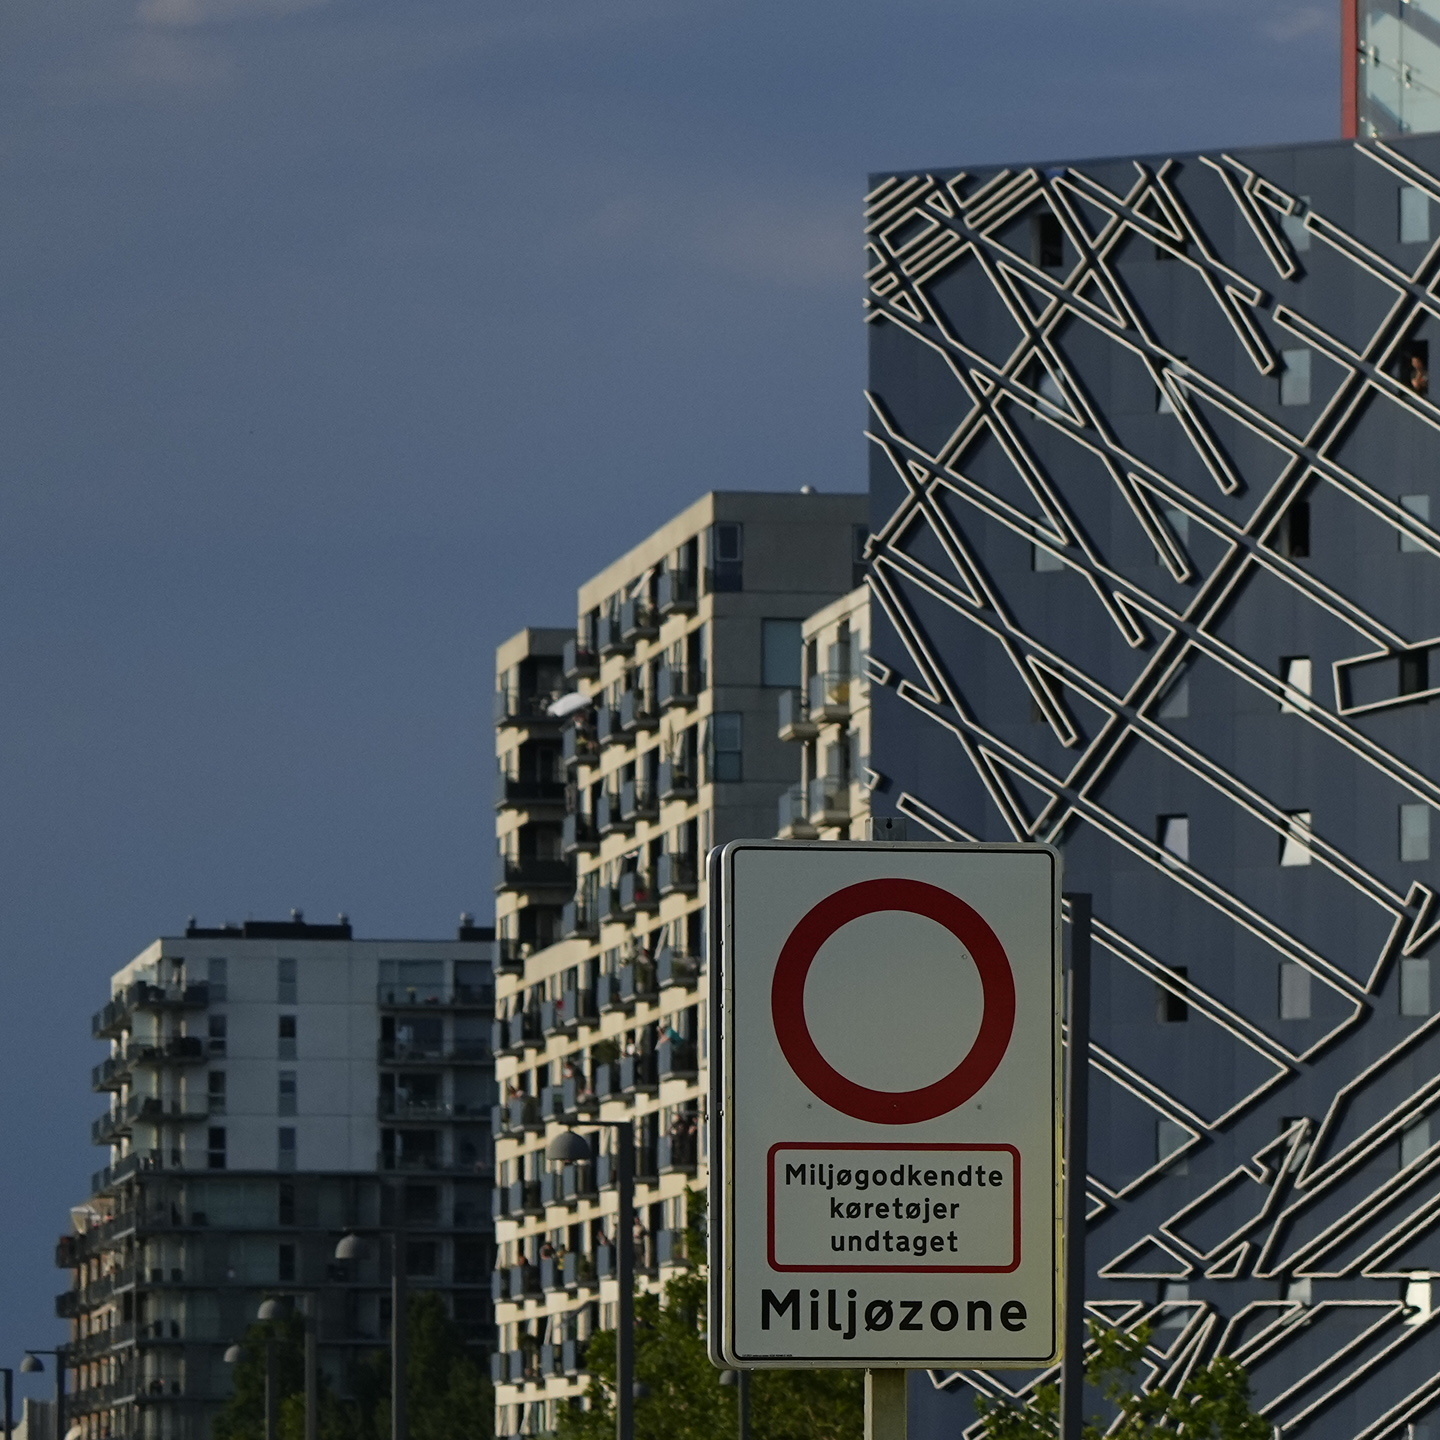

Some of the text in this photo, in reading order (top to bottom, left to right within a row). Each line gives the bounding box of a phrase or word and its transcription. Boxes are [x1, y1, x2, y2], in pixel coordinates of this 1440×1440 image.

[784, 1162, 1004, 1194] Miljøgodkendte
[829, 1196, 960, 1224] køretøjer
[830, 1229, 959, 1258] undtaget
[760, 1288, 1028, 1340] Miljøzone
